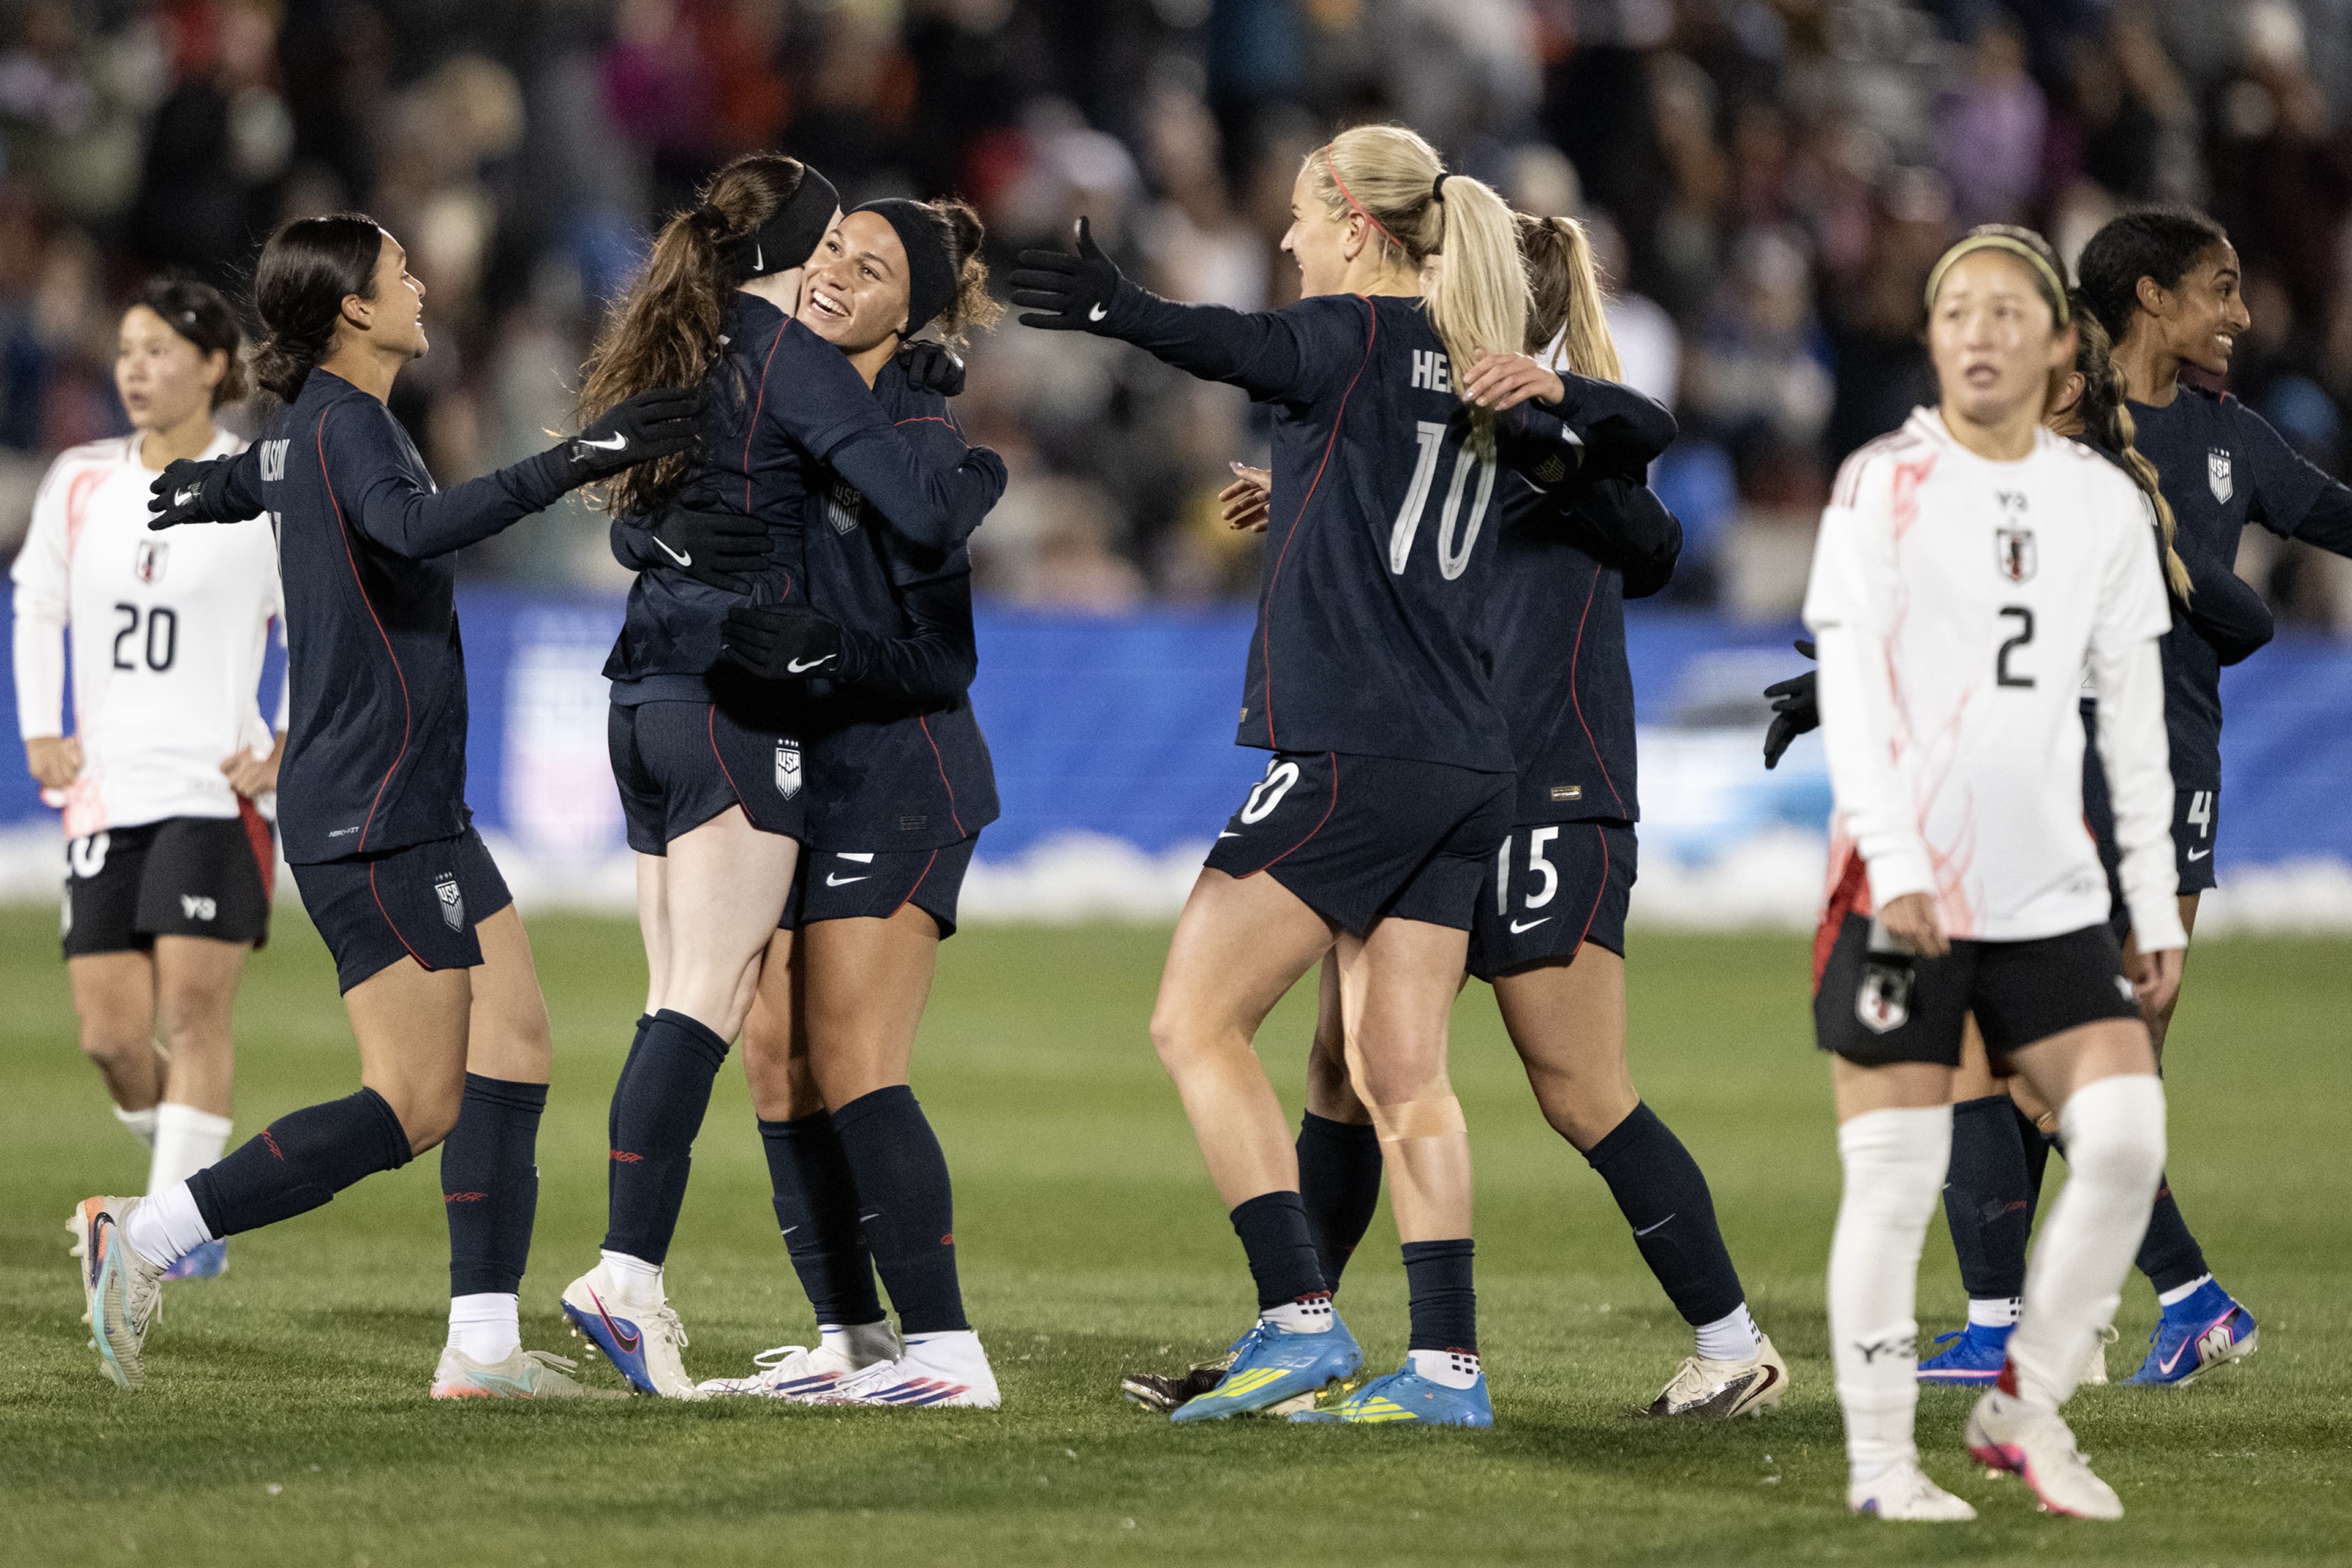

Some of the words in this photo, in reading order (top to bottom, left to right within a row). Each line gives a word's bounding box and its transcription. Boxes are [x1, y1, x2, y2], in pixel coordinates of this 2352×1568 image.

[2211, 457, 2230, 478] USA
[1390, 420, 1497, 580] 10
[112, 601, 178, 674] 20
[1996, 603, 2035, 689] 2
[778, 751, 799, 772] USA
[2187, 791, 2212, 838] 4
[438, 883, 460, 905] USA
[1497, 826, 1559, 916] 15
